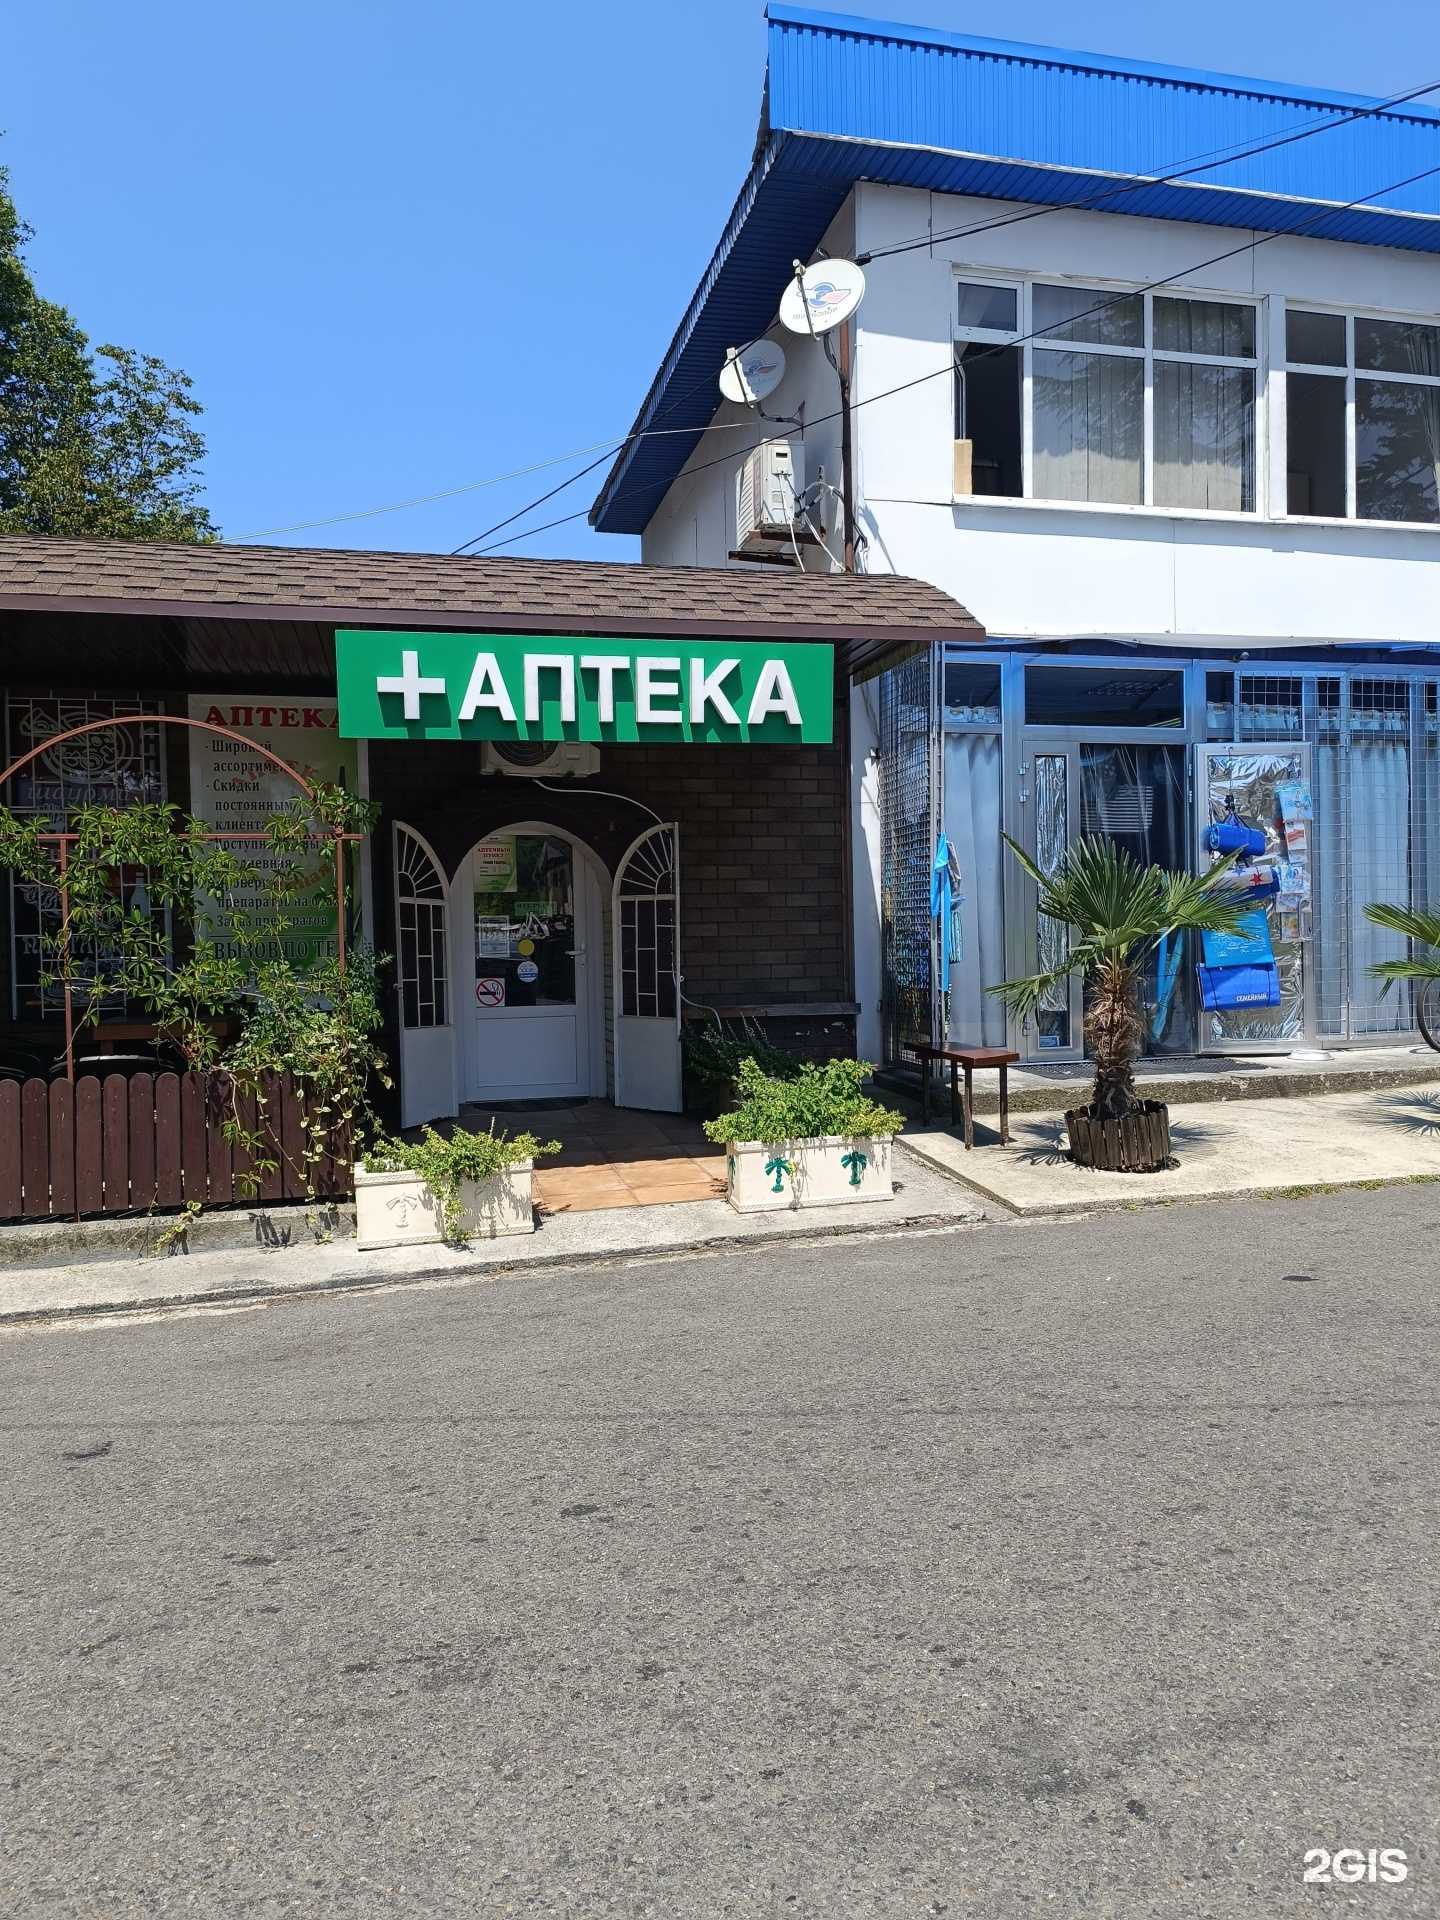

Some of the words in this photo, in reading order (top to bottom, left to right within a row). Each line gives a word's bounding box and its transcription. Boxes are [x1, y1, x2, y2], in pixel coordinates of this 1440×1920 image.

[458, 652, 803, 725] АПТЕКА
[212, 739, 272, 756] Широкй
[213, 779, 260, 793] Скидки
[256, 915, 327, 929] прератов
